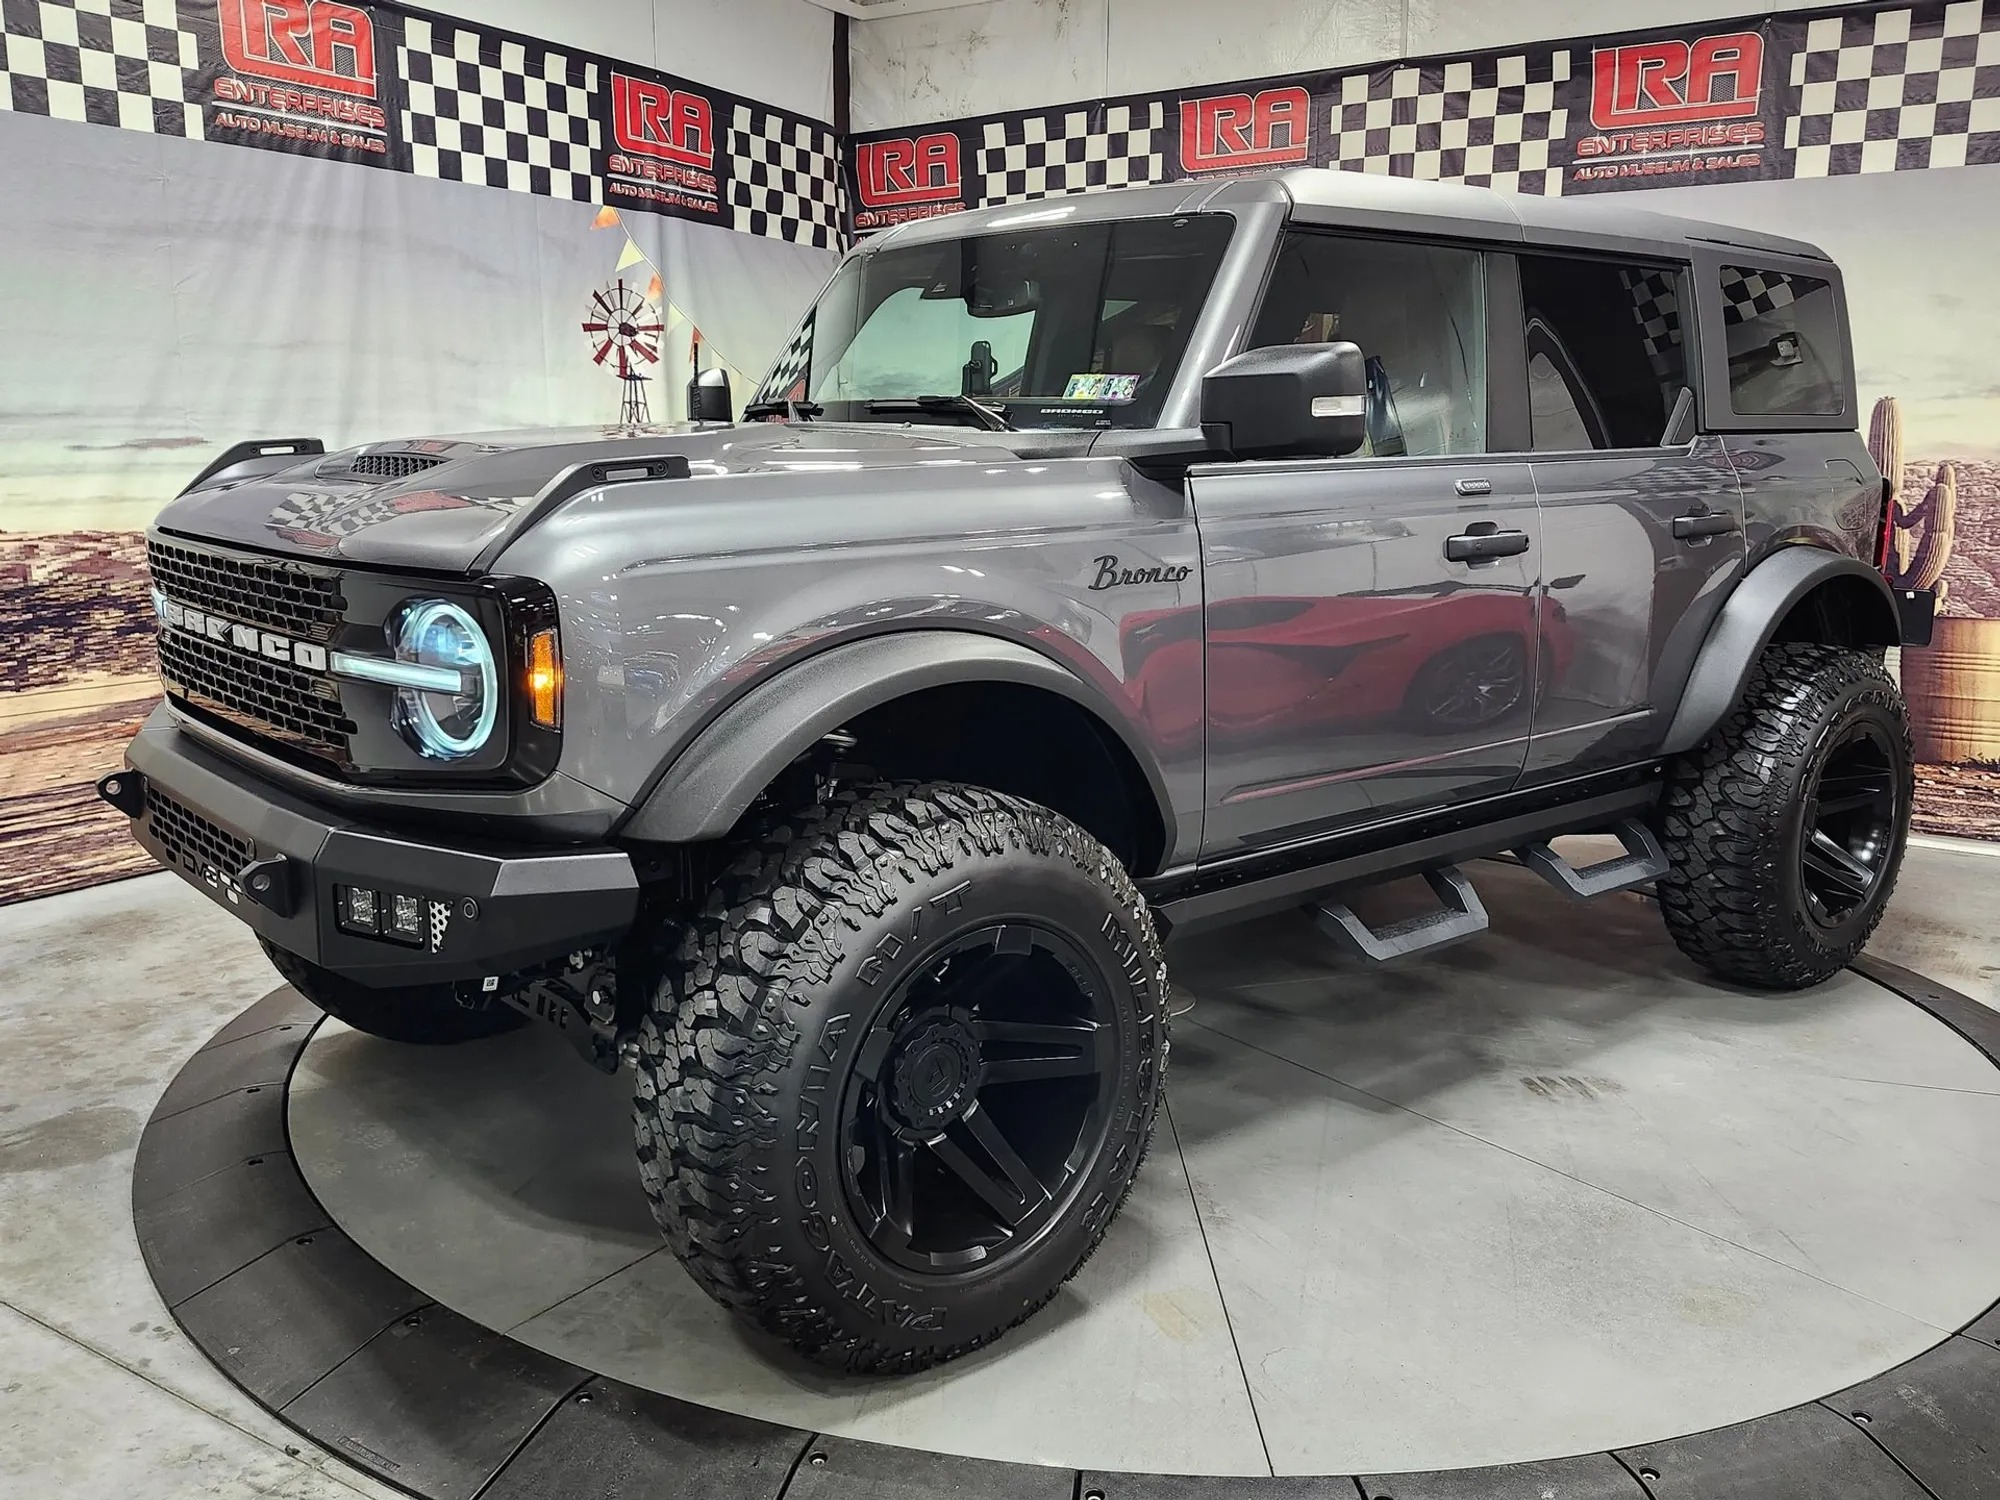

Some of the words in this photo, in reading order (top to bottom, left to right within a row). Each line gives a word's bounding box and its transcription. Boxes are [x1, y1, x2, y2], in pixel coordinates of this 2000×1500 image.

[217, 0, 378, 100] LRA
[213, 76, 387, 129] ENTERPRISES
[1590, 31, 1764, 130] LRA
[214, 112, 261, 132] AUTO
[262, 119, 328, 144] MUSEUM
[330, 131, 340, 145] &
[341, 133, 387, 154] SALES
[610, 71, 715, 170] LRA
[1178, 86, 1311, 173] LRA
[1576, 121, 1766, 157] ENTERPRISES
[608, 154, 718, 193] ENTERPRISES
[608, 182, 638, 197] AUTO
[856, 131, 961, 208] LRA
[1573, 166, 1618, 181] AUTO
[1619, 159, 1690, 178] MUSEUM
[1691, 157, 1704, 171] &
[1706, 153, 1762, 169] SALES
[1087, 554, 1194, 591] Bronco
